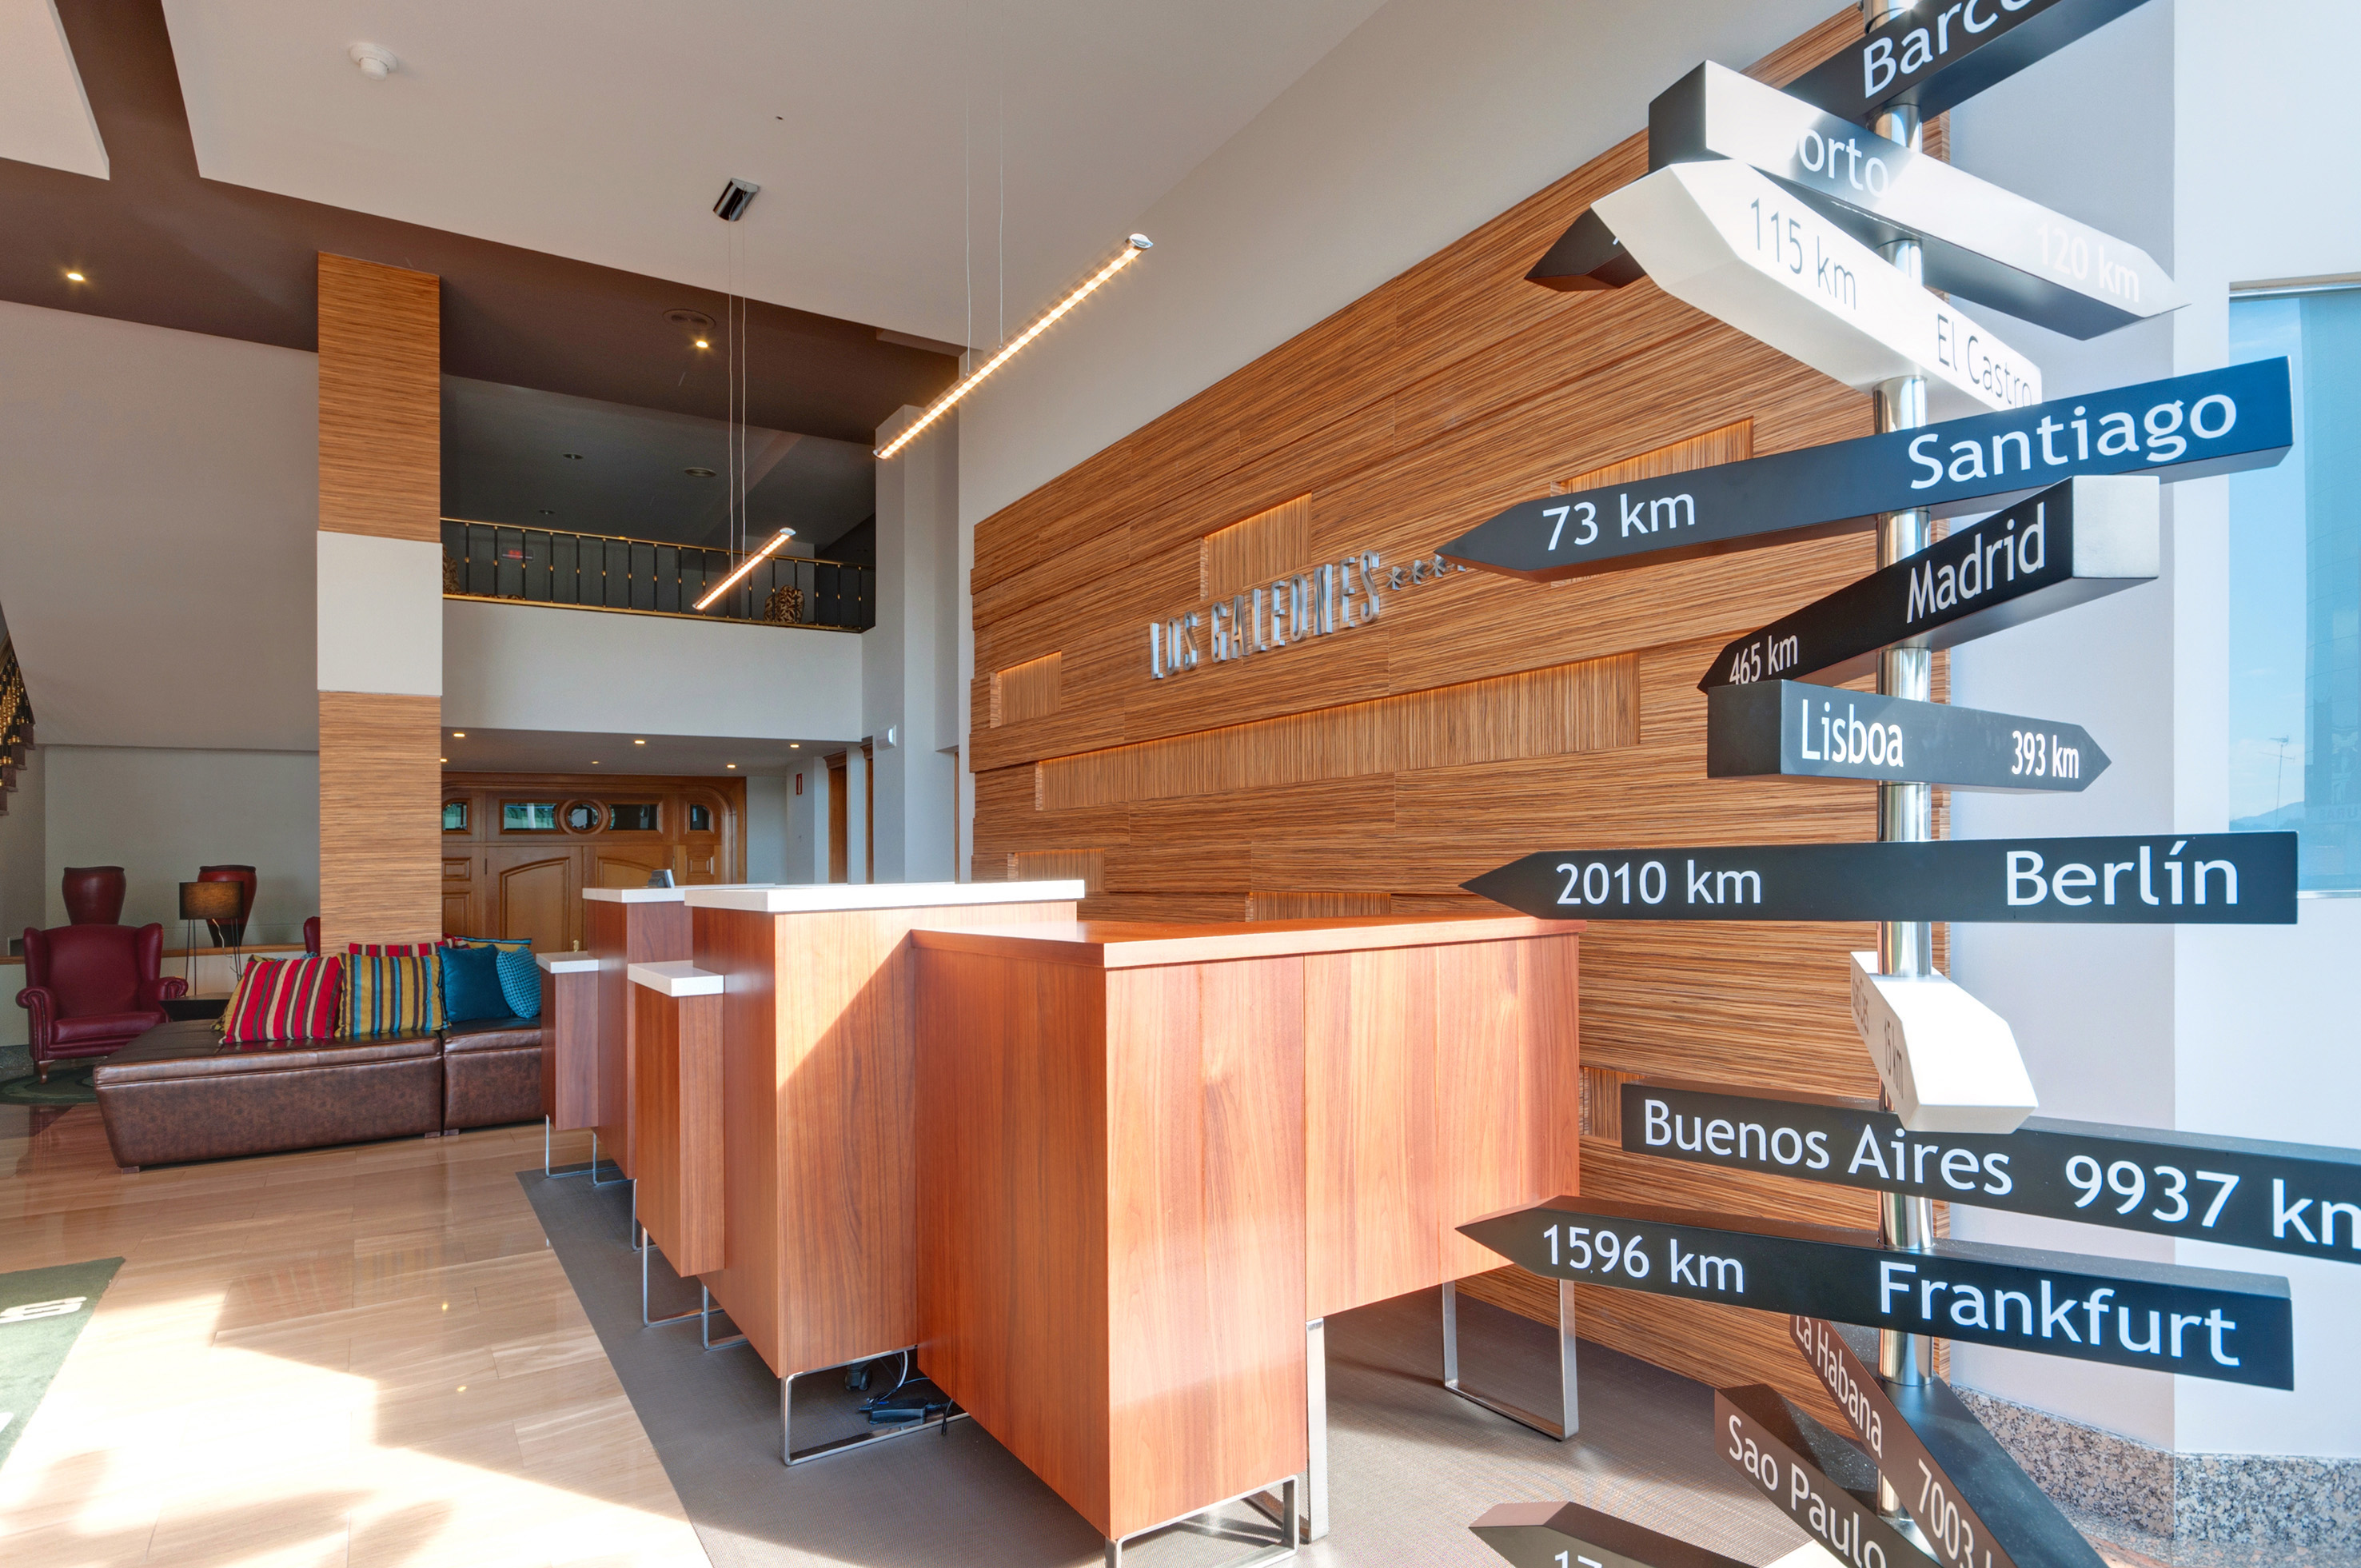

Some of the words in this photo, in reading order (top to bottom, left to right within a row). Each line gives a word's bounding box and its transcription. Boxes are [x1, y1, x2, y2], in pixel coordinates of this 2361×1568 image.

[1864, 0, 2034, 98] Barc
[1798, 128, 1889, 199] orto
[2036, 223, 2090, 281] 120
[2098, 247, 2140, 303] km
[1750, 197, 1804, 274] 115
[1817, 235, 1857, 310] km
[1937, 313, 1958, 373] El
[1967, 334, 2032, 409] Castro
[1542, 505, 1597, 552] 73
[1619, 493, 1696, 538] km
[1908, 393, 2237, 489] Santiago
[1150, 611, 1198, 680] LOS
[1210, 549, 1381, 664] GALEONES
[1729, 642, 1761, 685] 465
[1768, 634, 1798, 676] km
[1907, 501, 2045, 624] Madrid
[1801, 698, 1904, 768] Lisboa
[2012, 730, 2047, 776] 393
[2052, 734, 2080, 779] km
[1556, 860, 1667, 906] 2010
[1689, 860, 1761, 905] km
[2005, 840, 2238, 906] Berlín
[1884, 1017, 1892, 1076] 15
[1892, 1025, 1904, 1100] km
[1644, 1099, 1831, 1171] Buenos
[1848, 1123, 2014, 1196] Aires
[2065, 1155, 2240, 1228] 9937
[1543, 1223, 1651, 1279] 1596
[1669, 1239, 1745, 1294] km
[1880, 1259, 2240, 1368] Frankfurt
[1728, 1414, 1779, 1492] Sao
[1790, 1462, 1887, 1568] Paulo
[1795, 1315, 1813, 1355] La
[1817, 1321, 1883, 1459] Habana
[1918, 1458, 1974, 1568] 7003
